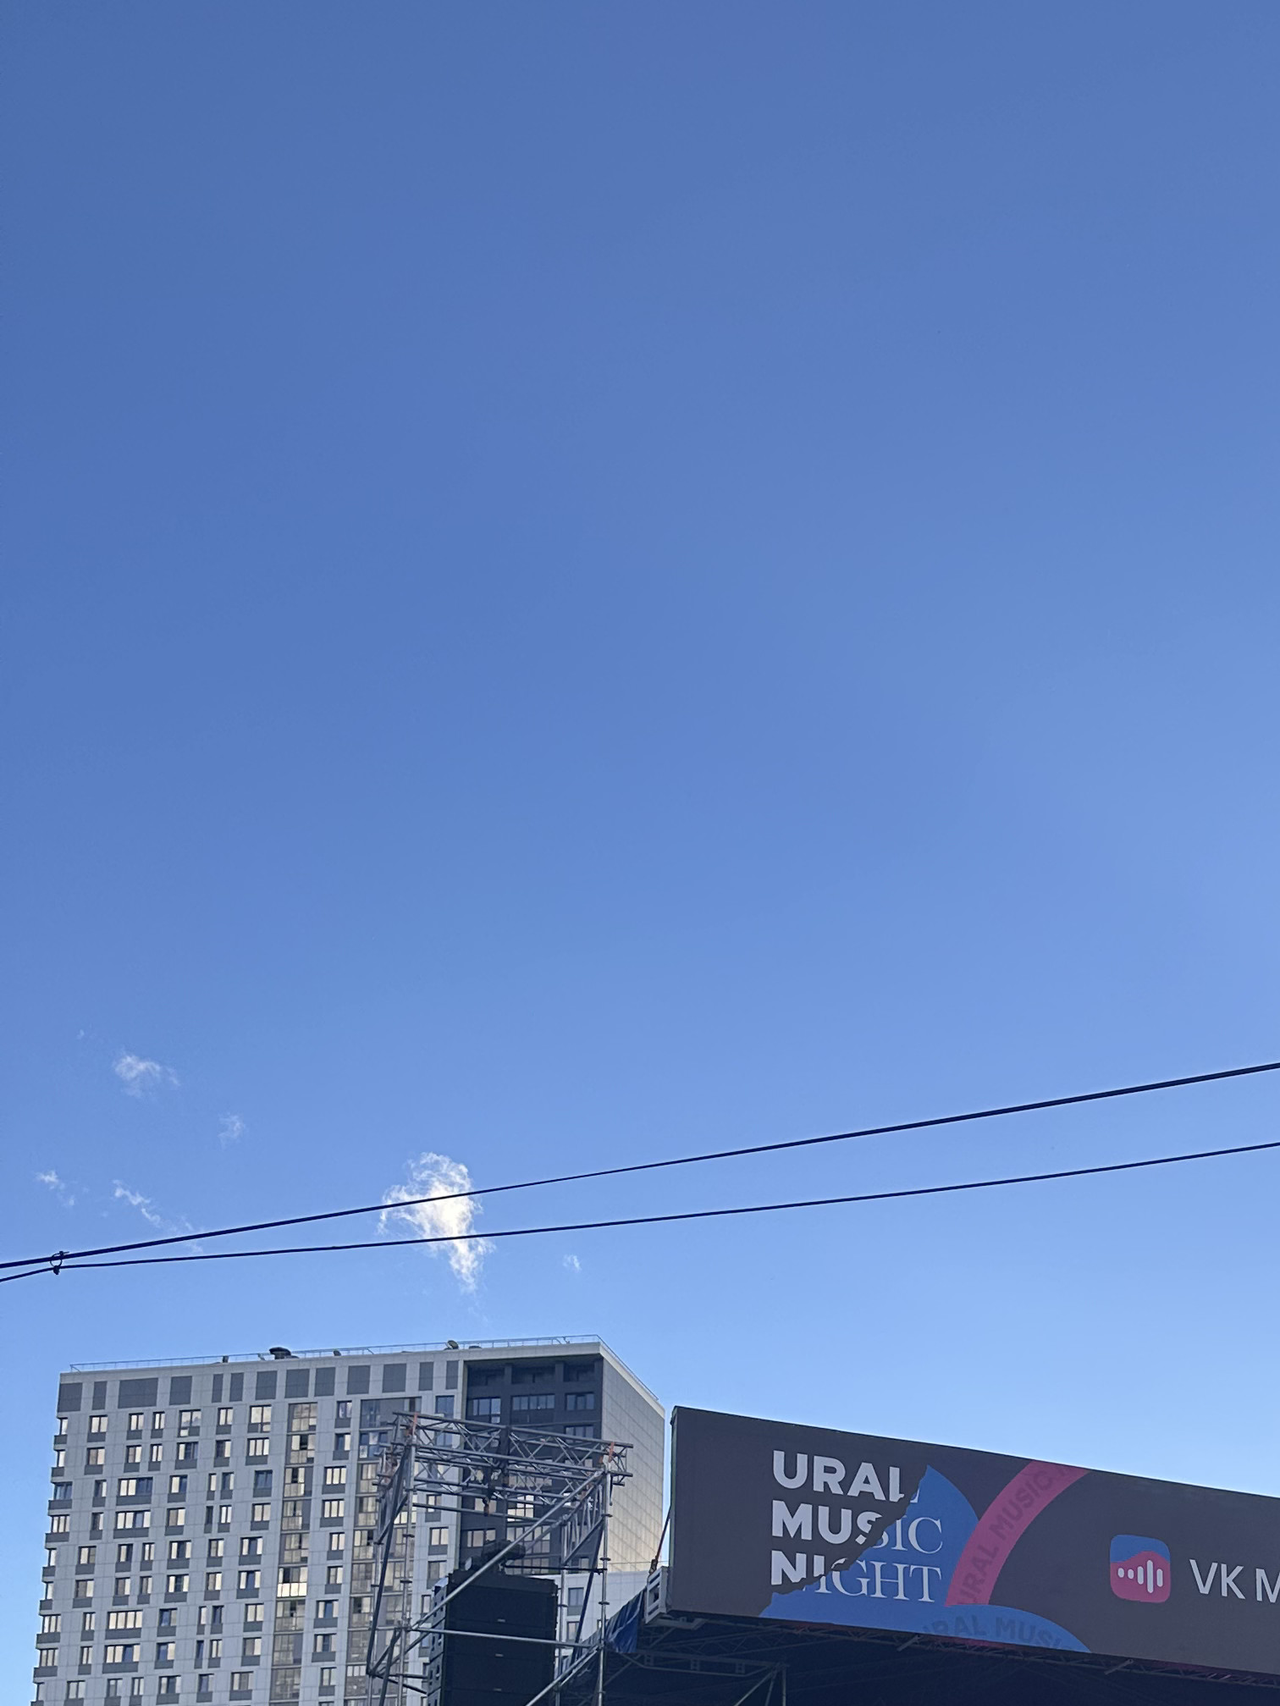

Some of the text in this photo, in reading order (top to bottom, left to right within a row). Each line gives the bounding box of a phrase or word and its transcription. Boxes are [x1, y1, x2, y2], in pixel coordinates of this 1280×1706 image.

[773, 1450, 919, 1503] URAL
[771, 1500, 943, 1555] MUSIC
[989, 1469, 1054, 1541] MUSIC
[771, 1550, 942, 1603] NIGHT
[1189, 1558, 1246, 1600] VK
[922, 1614, 988, 1635] RAL
